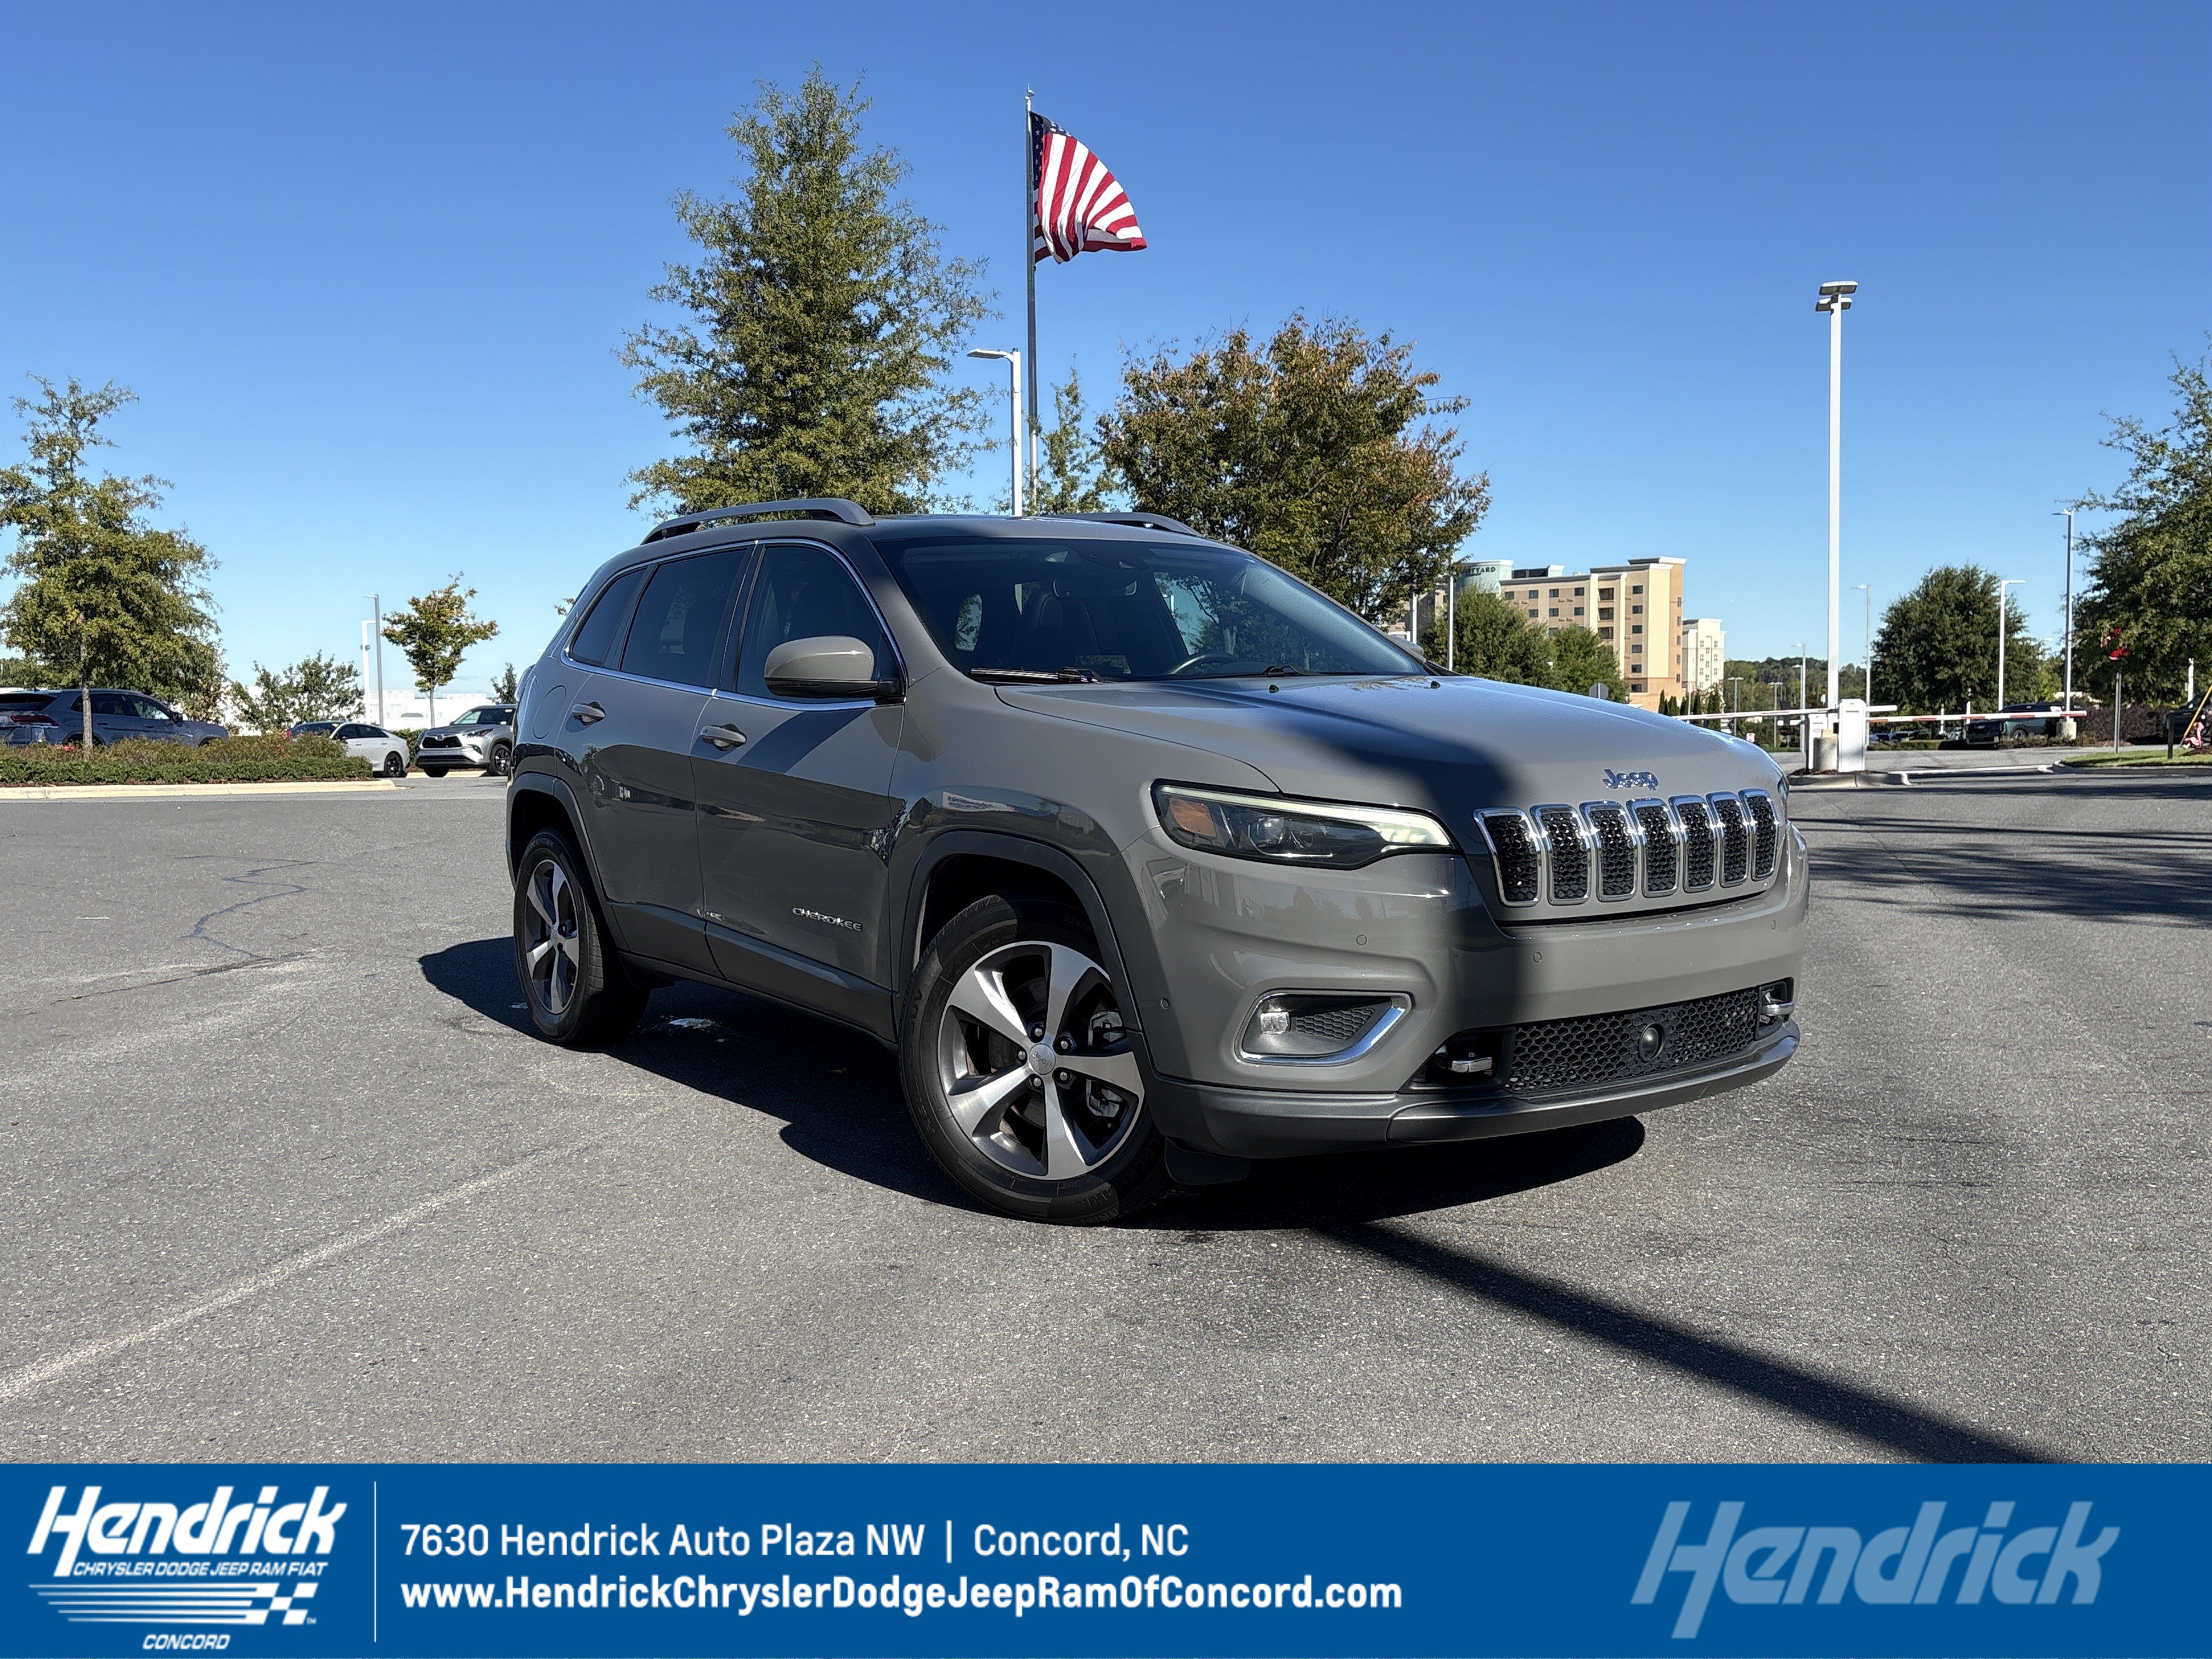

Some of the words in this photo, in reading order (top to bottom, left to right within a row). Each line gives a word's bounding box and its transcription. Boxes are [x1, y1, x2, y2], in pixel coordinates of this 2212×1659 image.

[1602, 769, 1658, 791] Jeep
[792, 907, 864, 932] CHEROKEE
[909, 988, 923, 1036] SUV
[1031, 1051, 1052, 1068] Jeep
